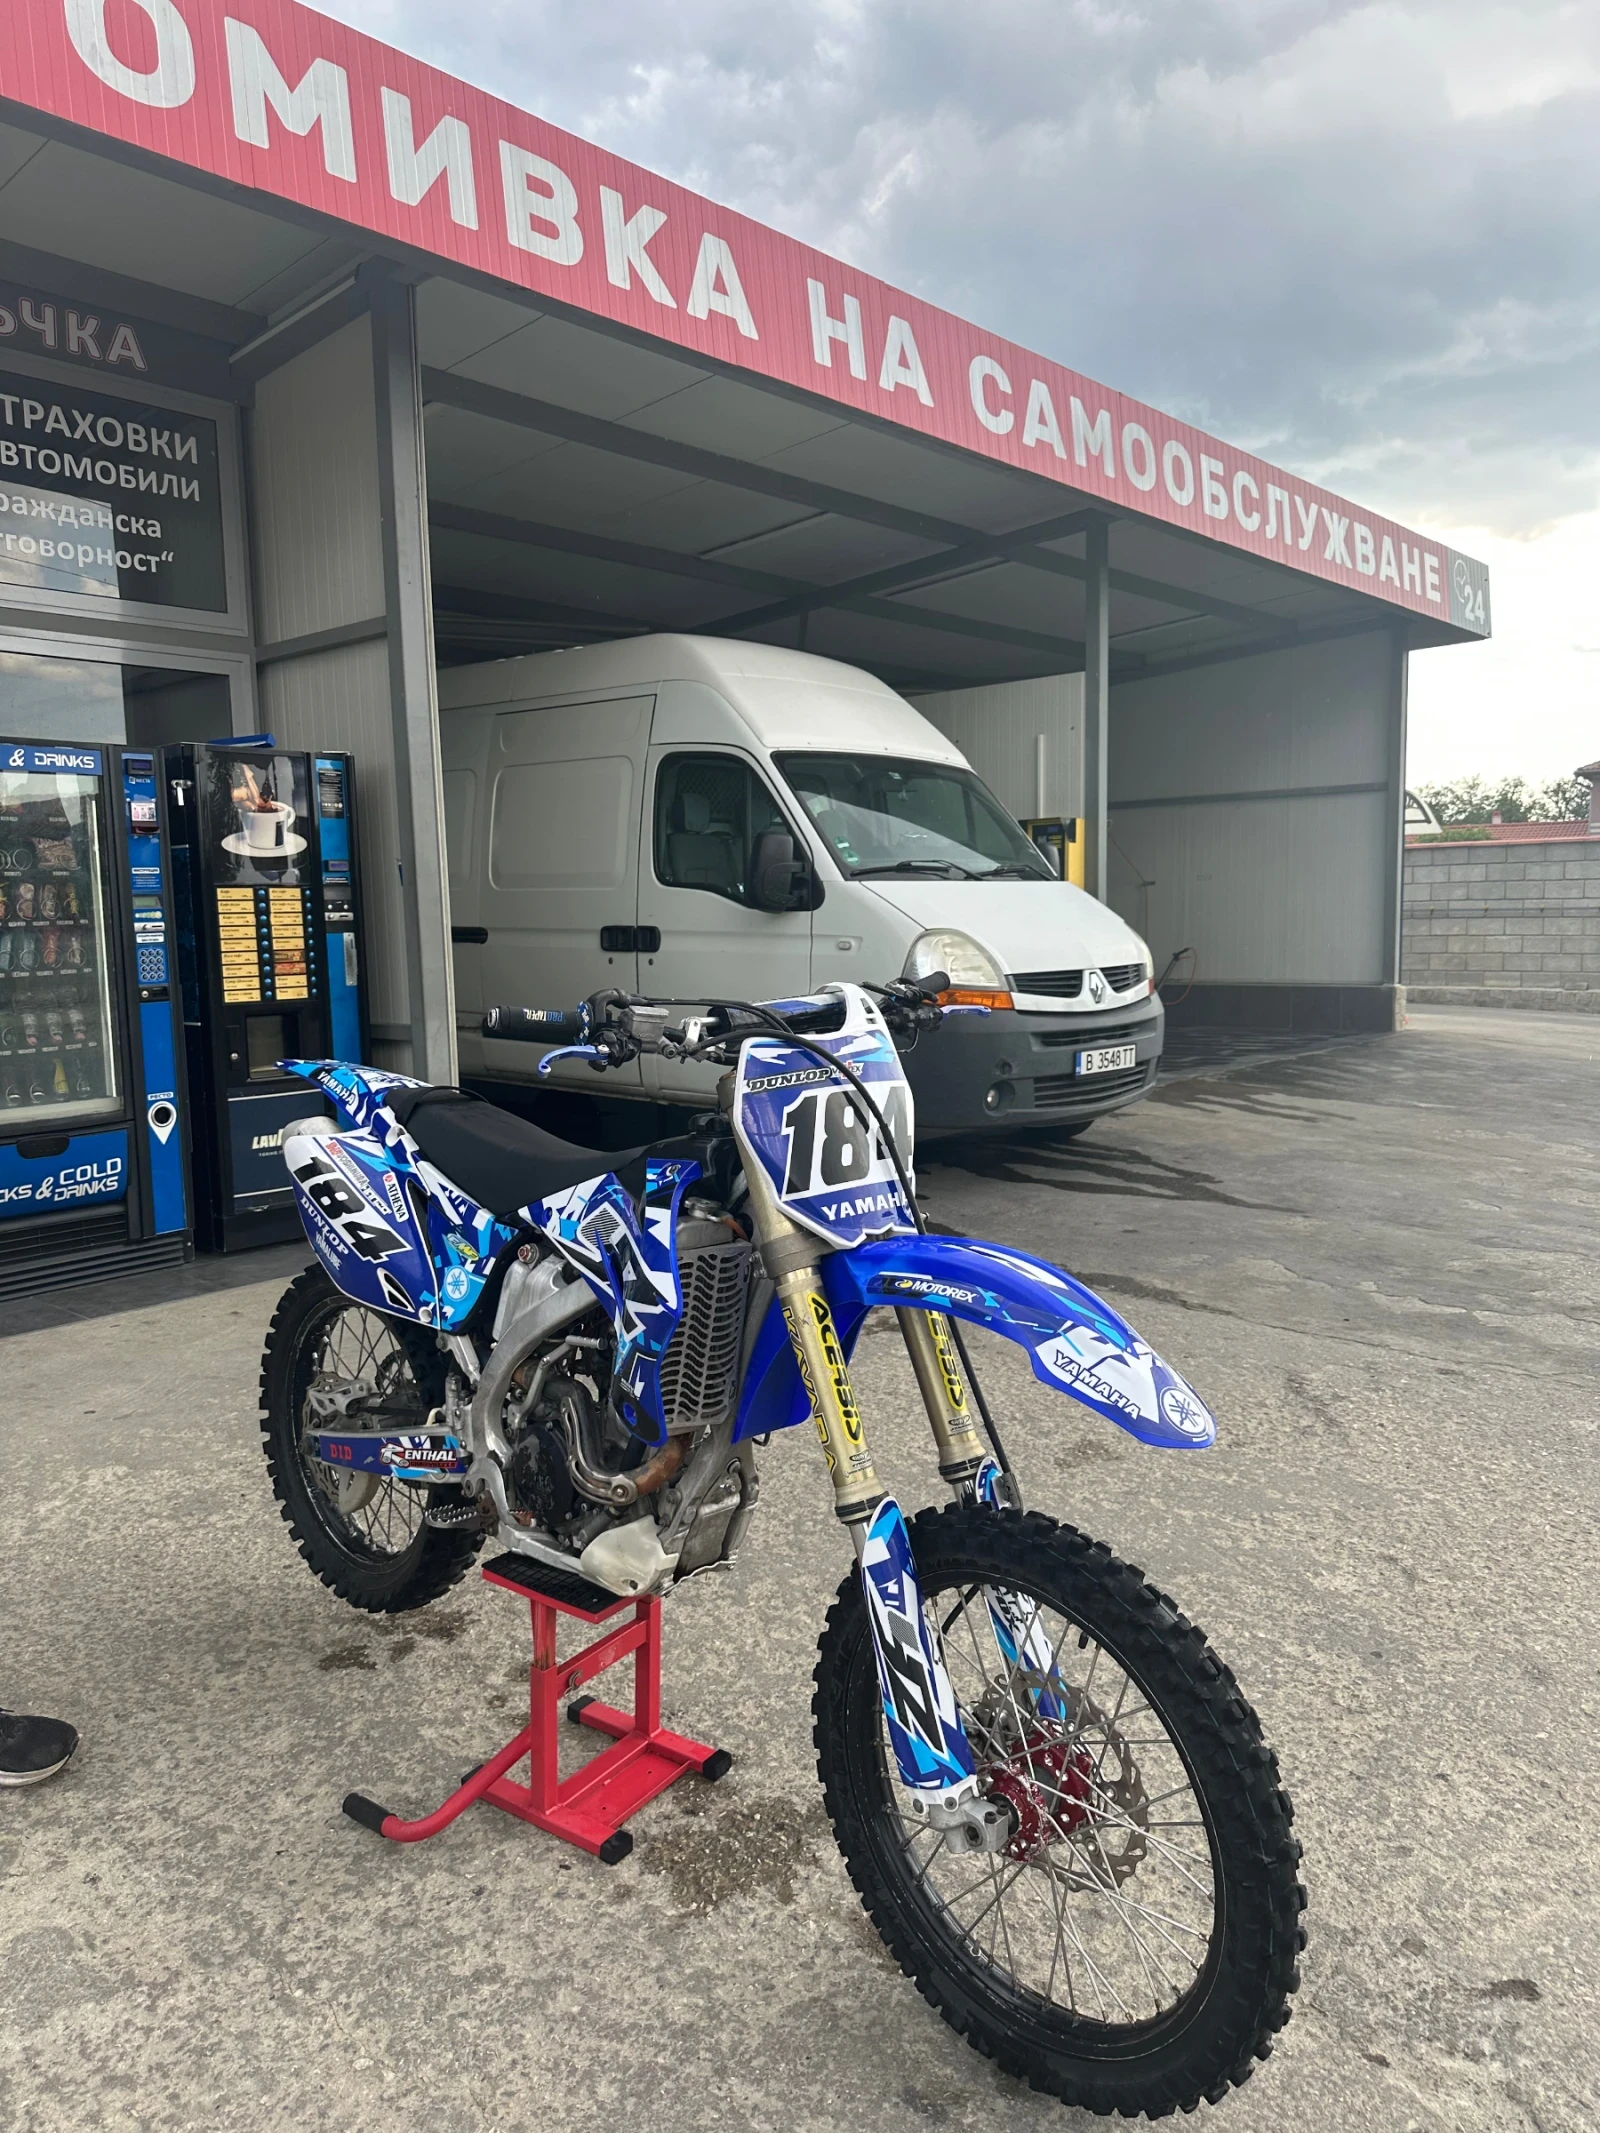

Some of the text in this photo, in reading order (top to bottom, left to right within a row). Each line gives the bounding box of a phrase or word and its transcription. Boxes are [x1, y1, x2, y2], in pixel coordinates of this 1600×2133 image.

[806, 277, 935, 408] НА
[968, 355, 1442, 603] САМООБСЛУЖВАНЕ
[0, 532, 174, 573] говорност“
[1463, 581, 1486, 625] 24
[9, 748, 95, 769] & DRINKS
[750, 1067, 832, 1092] DUNLOP
[1097, 1049, 1121, 1069] 3548
[317, 1071, 356, 1106] YAMAHA
[785, 1086, 912, 1195] 184
[35, 1176, 55, 1200] &
[59, 1157, 122, 1185] COLD
[54, 1176, 119, 1202] DRINKS
[293, 1156, 408, 1262] 184
[387, 1182, 408, 1219] ATHENA
[301, 1196, 350, 1255] DUNLOP
[315, 1230, 343, 1271] YAMALUBE
[911, 1279, 977, 1304] MOTOREX
[1053, 1350, 1142, 1420] YAMAHA
[330, 1443, 352, 1461] DID
